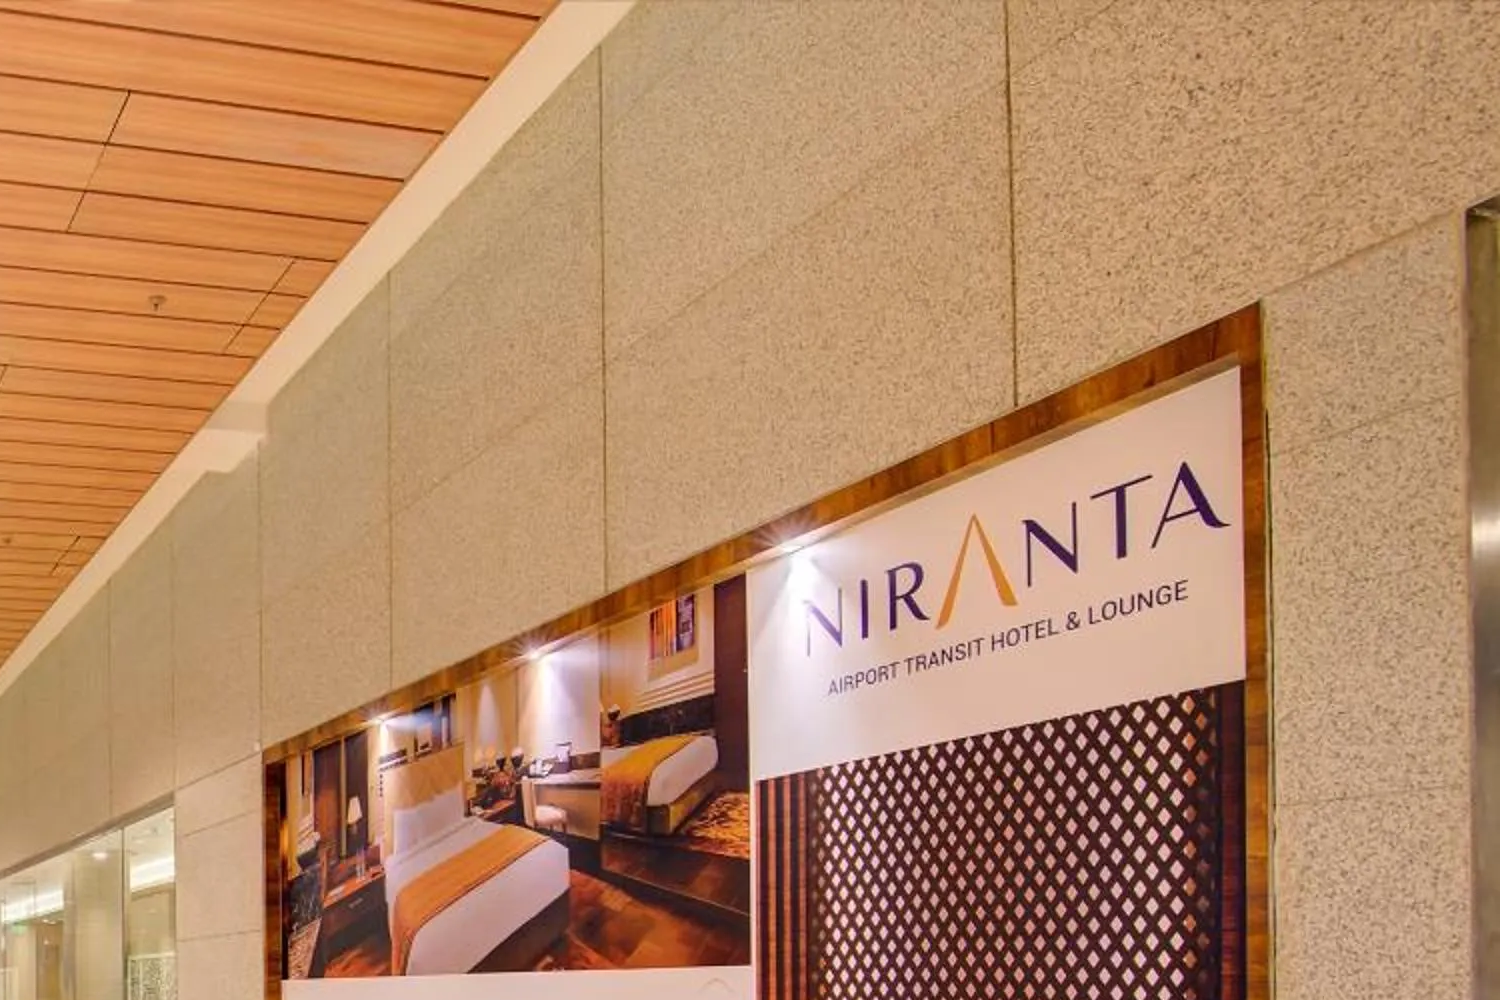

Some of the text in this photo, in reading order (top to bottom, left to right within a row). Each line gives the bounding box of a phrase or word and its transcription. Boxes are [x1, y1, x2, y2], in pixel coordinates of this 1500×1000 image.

[803, 460, 1231, 657] NIRANTA
[828, 579, 1190, 697] AIRPORT TRANSIT HOTEL & LOUNGE
